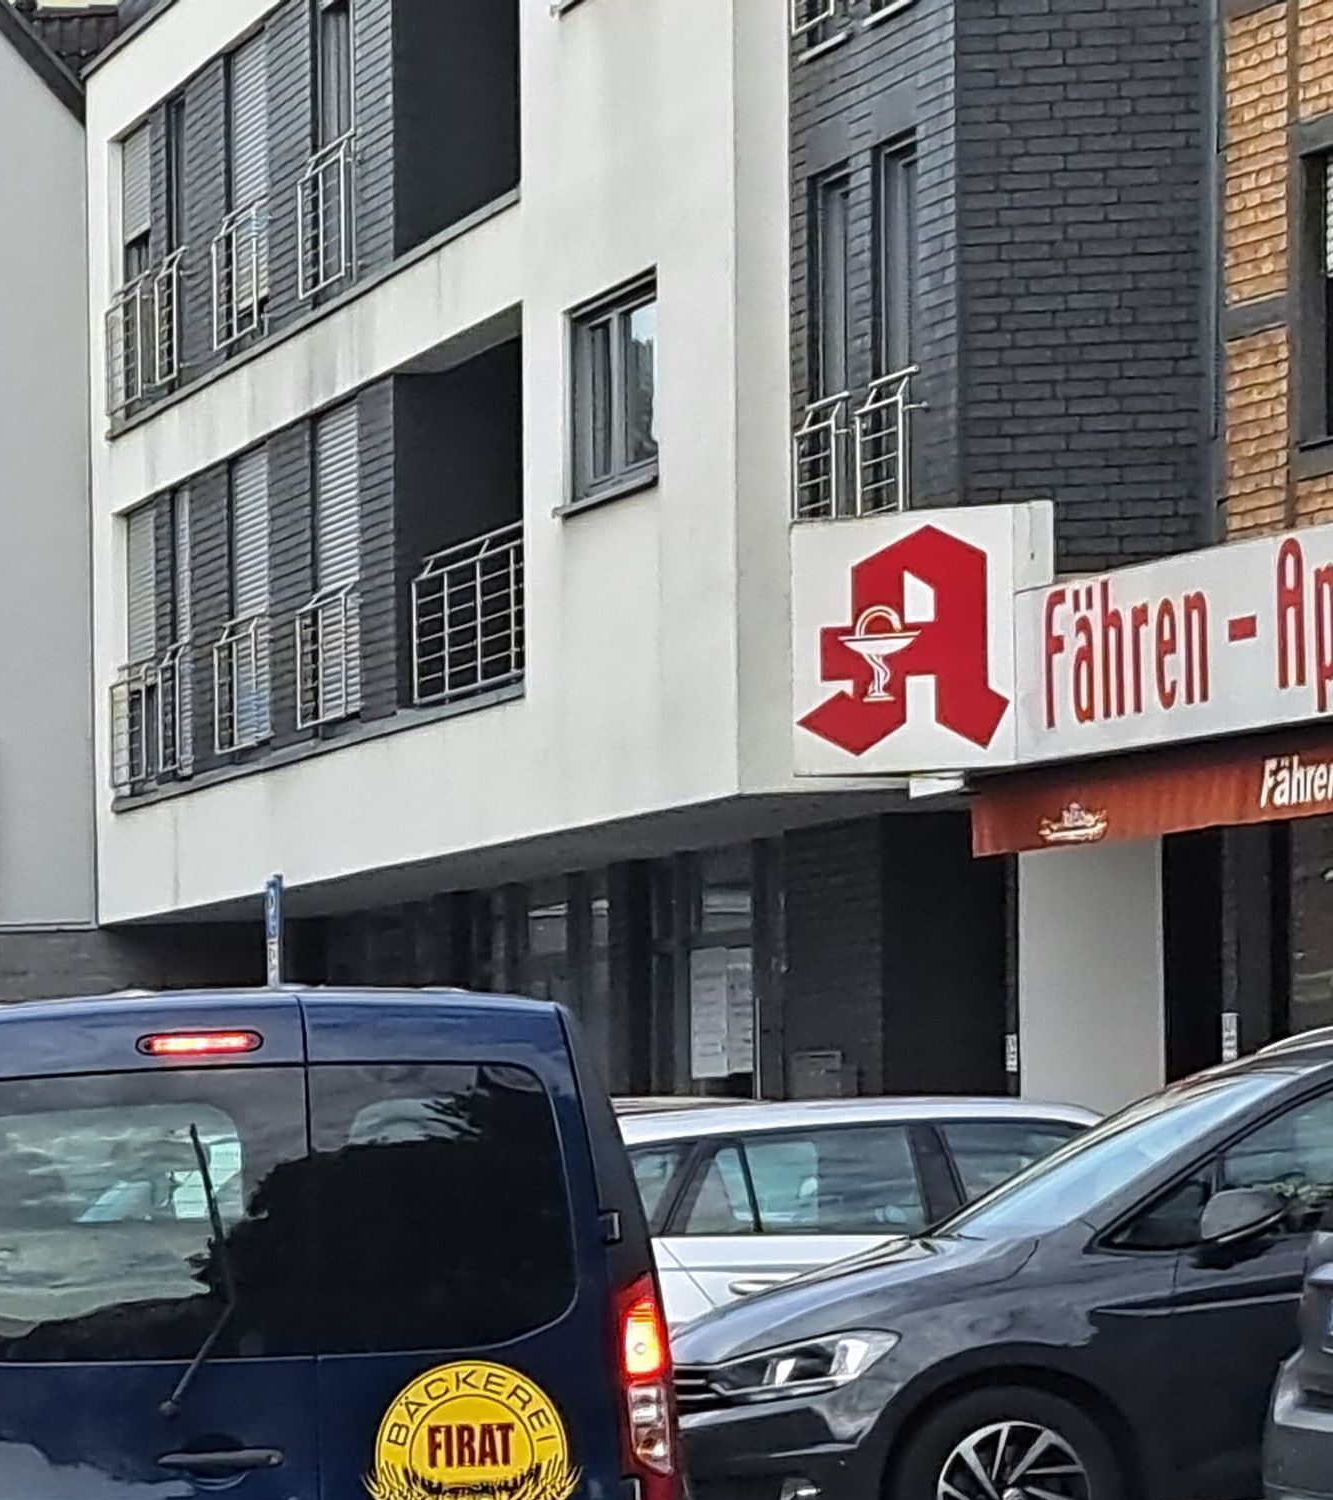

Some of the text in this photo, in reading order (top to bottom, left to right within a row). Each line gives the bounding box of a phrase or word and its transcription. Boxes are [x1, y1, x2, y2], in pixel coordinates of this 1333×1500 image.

[1044, 578, 1209, 729] Fähren
[386, 1369, 557, 1447] BÄCKEREI
[427, 1422, 515, 1468] FIRAT
